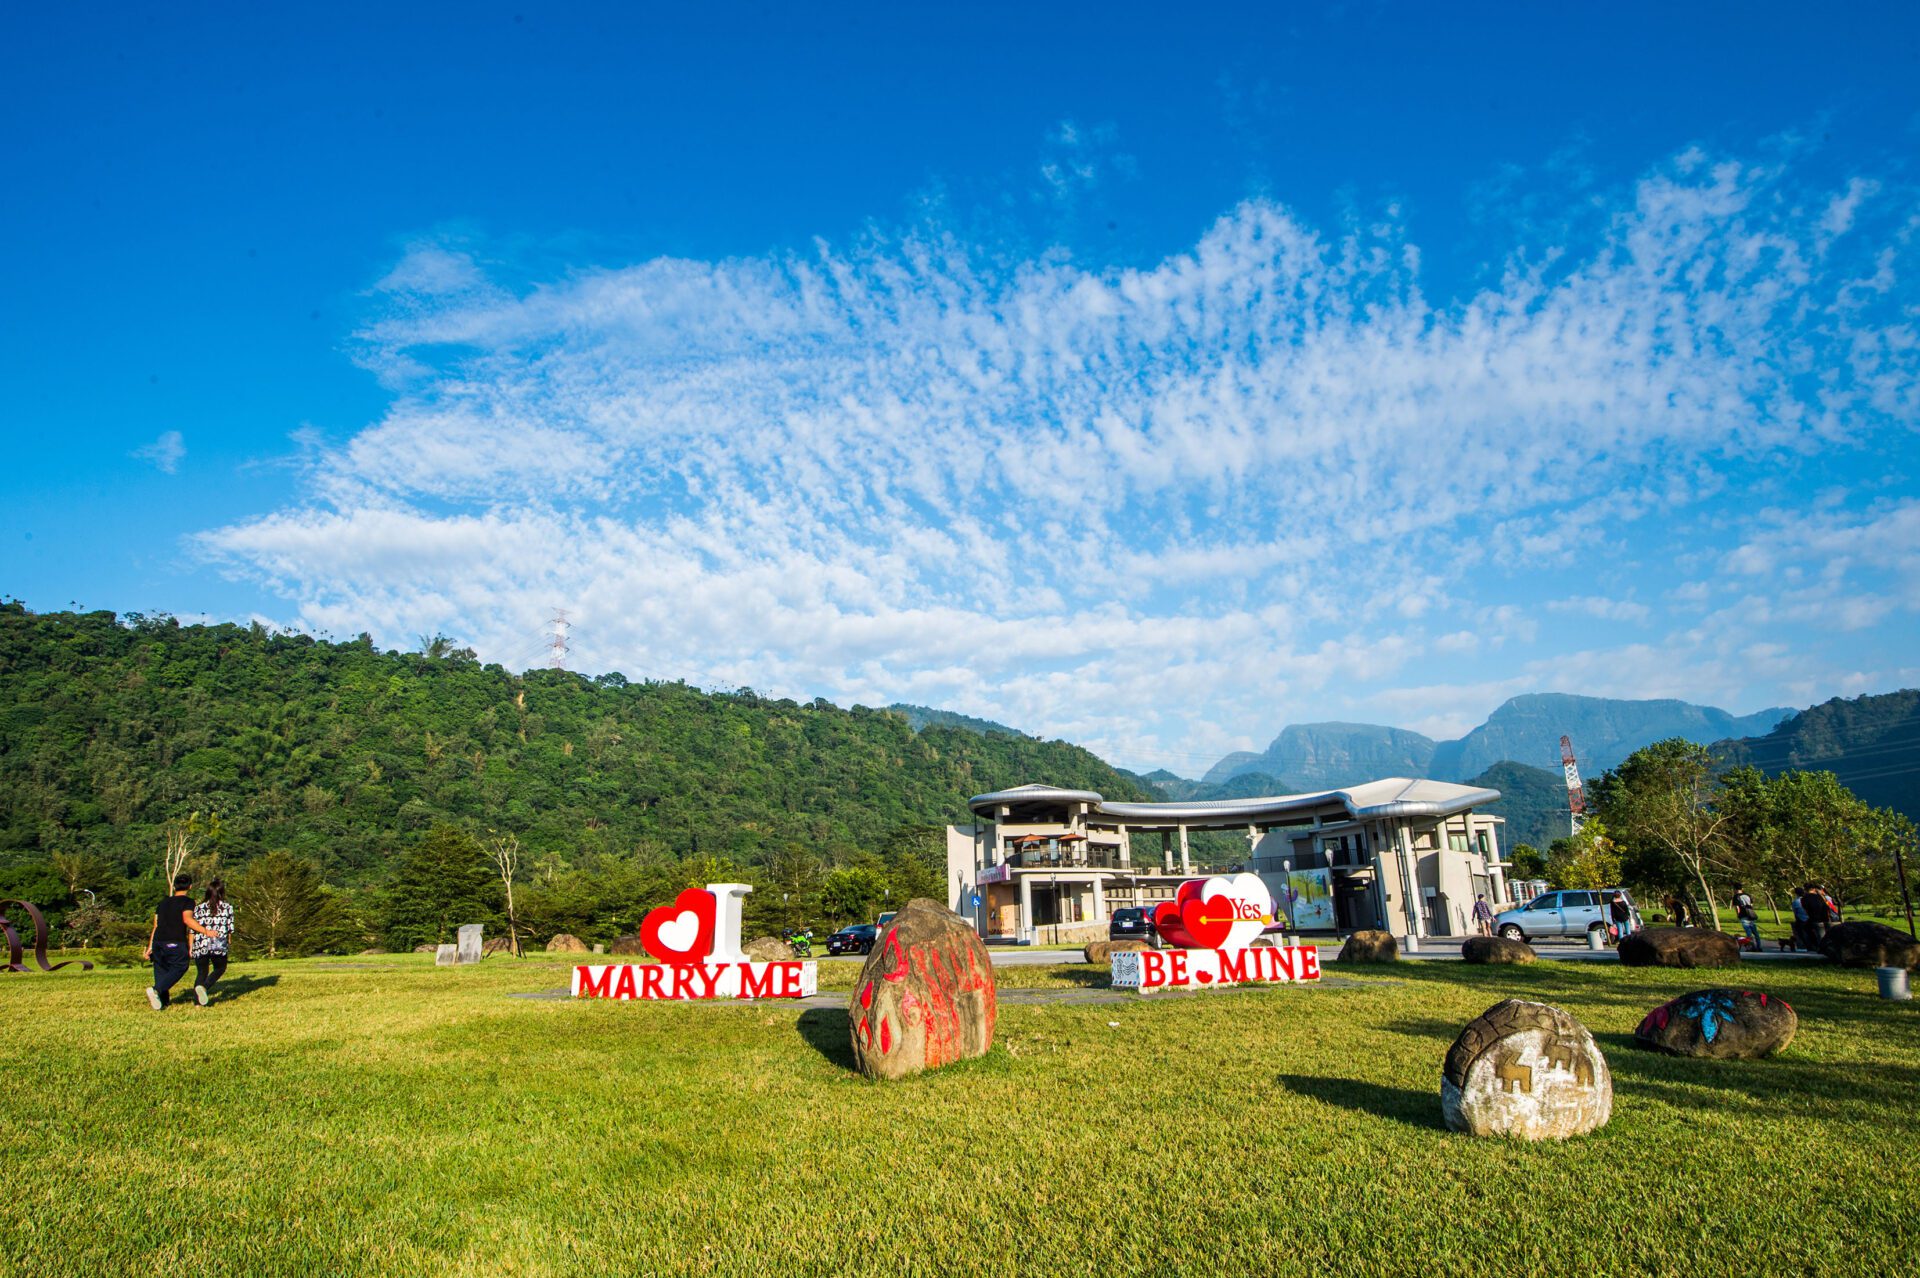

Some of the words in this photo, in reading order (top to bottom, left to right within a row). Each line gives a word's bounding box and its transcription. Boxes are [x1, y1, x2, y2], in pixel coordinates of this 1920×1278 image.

[703, 883, 753, 963] I
[1230, 898, 1261, 919] Yes
[577, 964, 730, 999] MARRY
[738, 962, 802, 998] ME
[1141, 951, 1190, 987] BE
[1217, 946, 1320, 983] MINE
